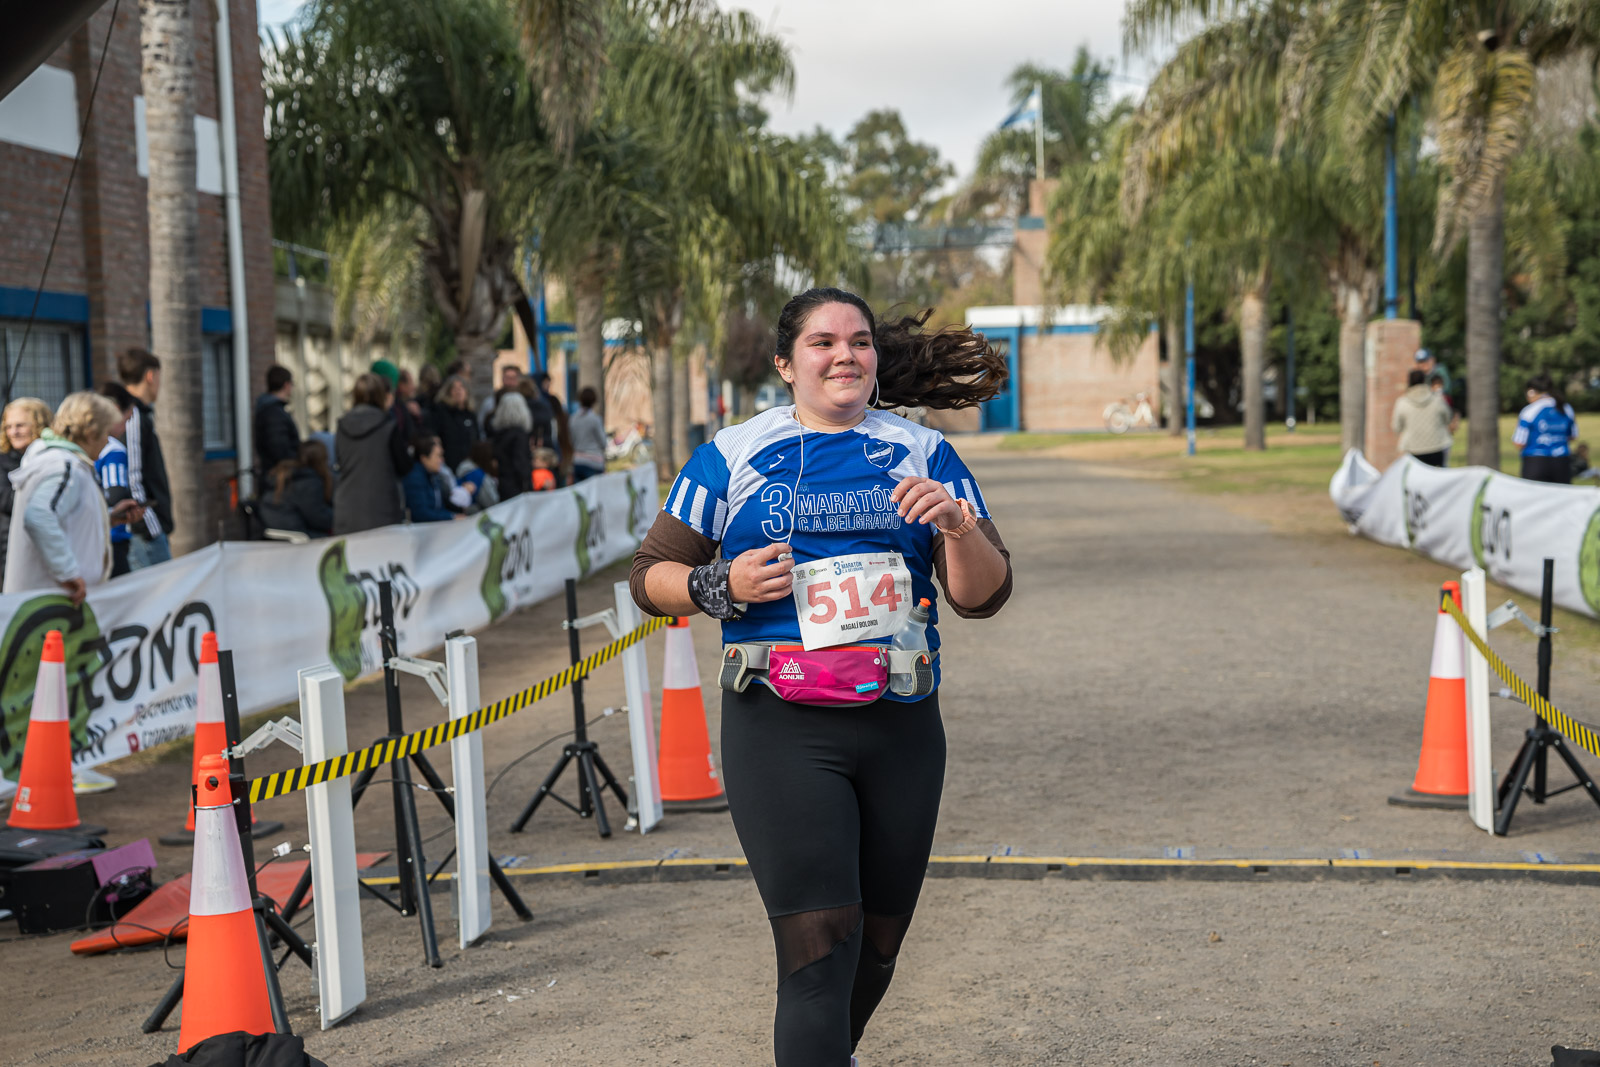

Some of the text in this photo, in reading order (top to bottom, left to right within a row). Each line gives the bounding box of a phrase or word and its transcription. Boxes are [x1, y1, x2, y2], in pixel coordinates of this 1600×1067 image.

[761, 482, 794, 541] 3
[796, 484, 901, 516] MARATÓN
[807, 573, 902, 625] 514
